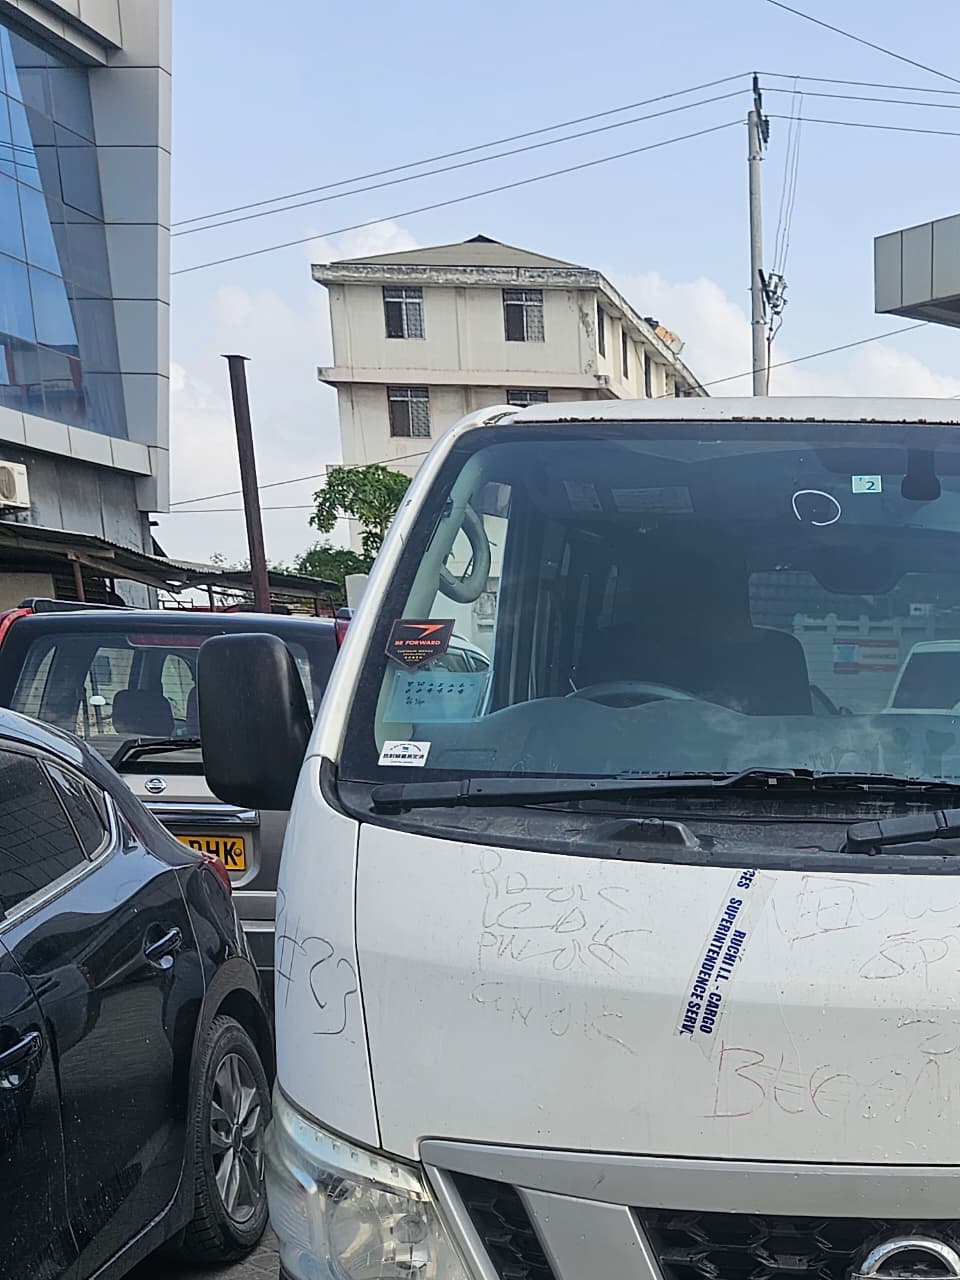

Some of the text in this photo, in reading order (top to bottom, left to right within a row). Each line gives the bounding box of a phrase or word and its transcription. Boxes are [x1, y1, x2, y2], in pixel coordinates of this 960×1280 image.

[690, 897, 743, 1001] SUPERINTENDENCE
[721, 930, 747, 967] RUCHI
[680, 1000, 703, 1037] SERV
[699, 993, 722, 1034] CARGO
